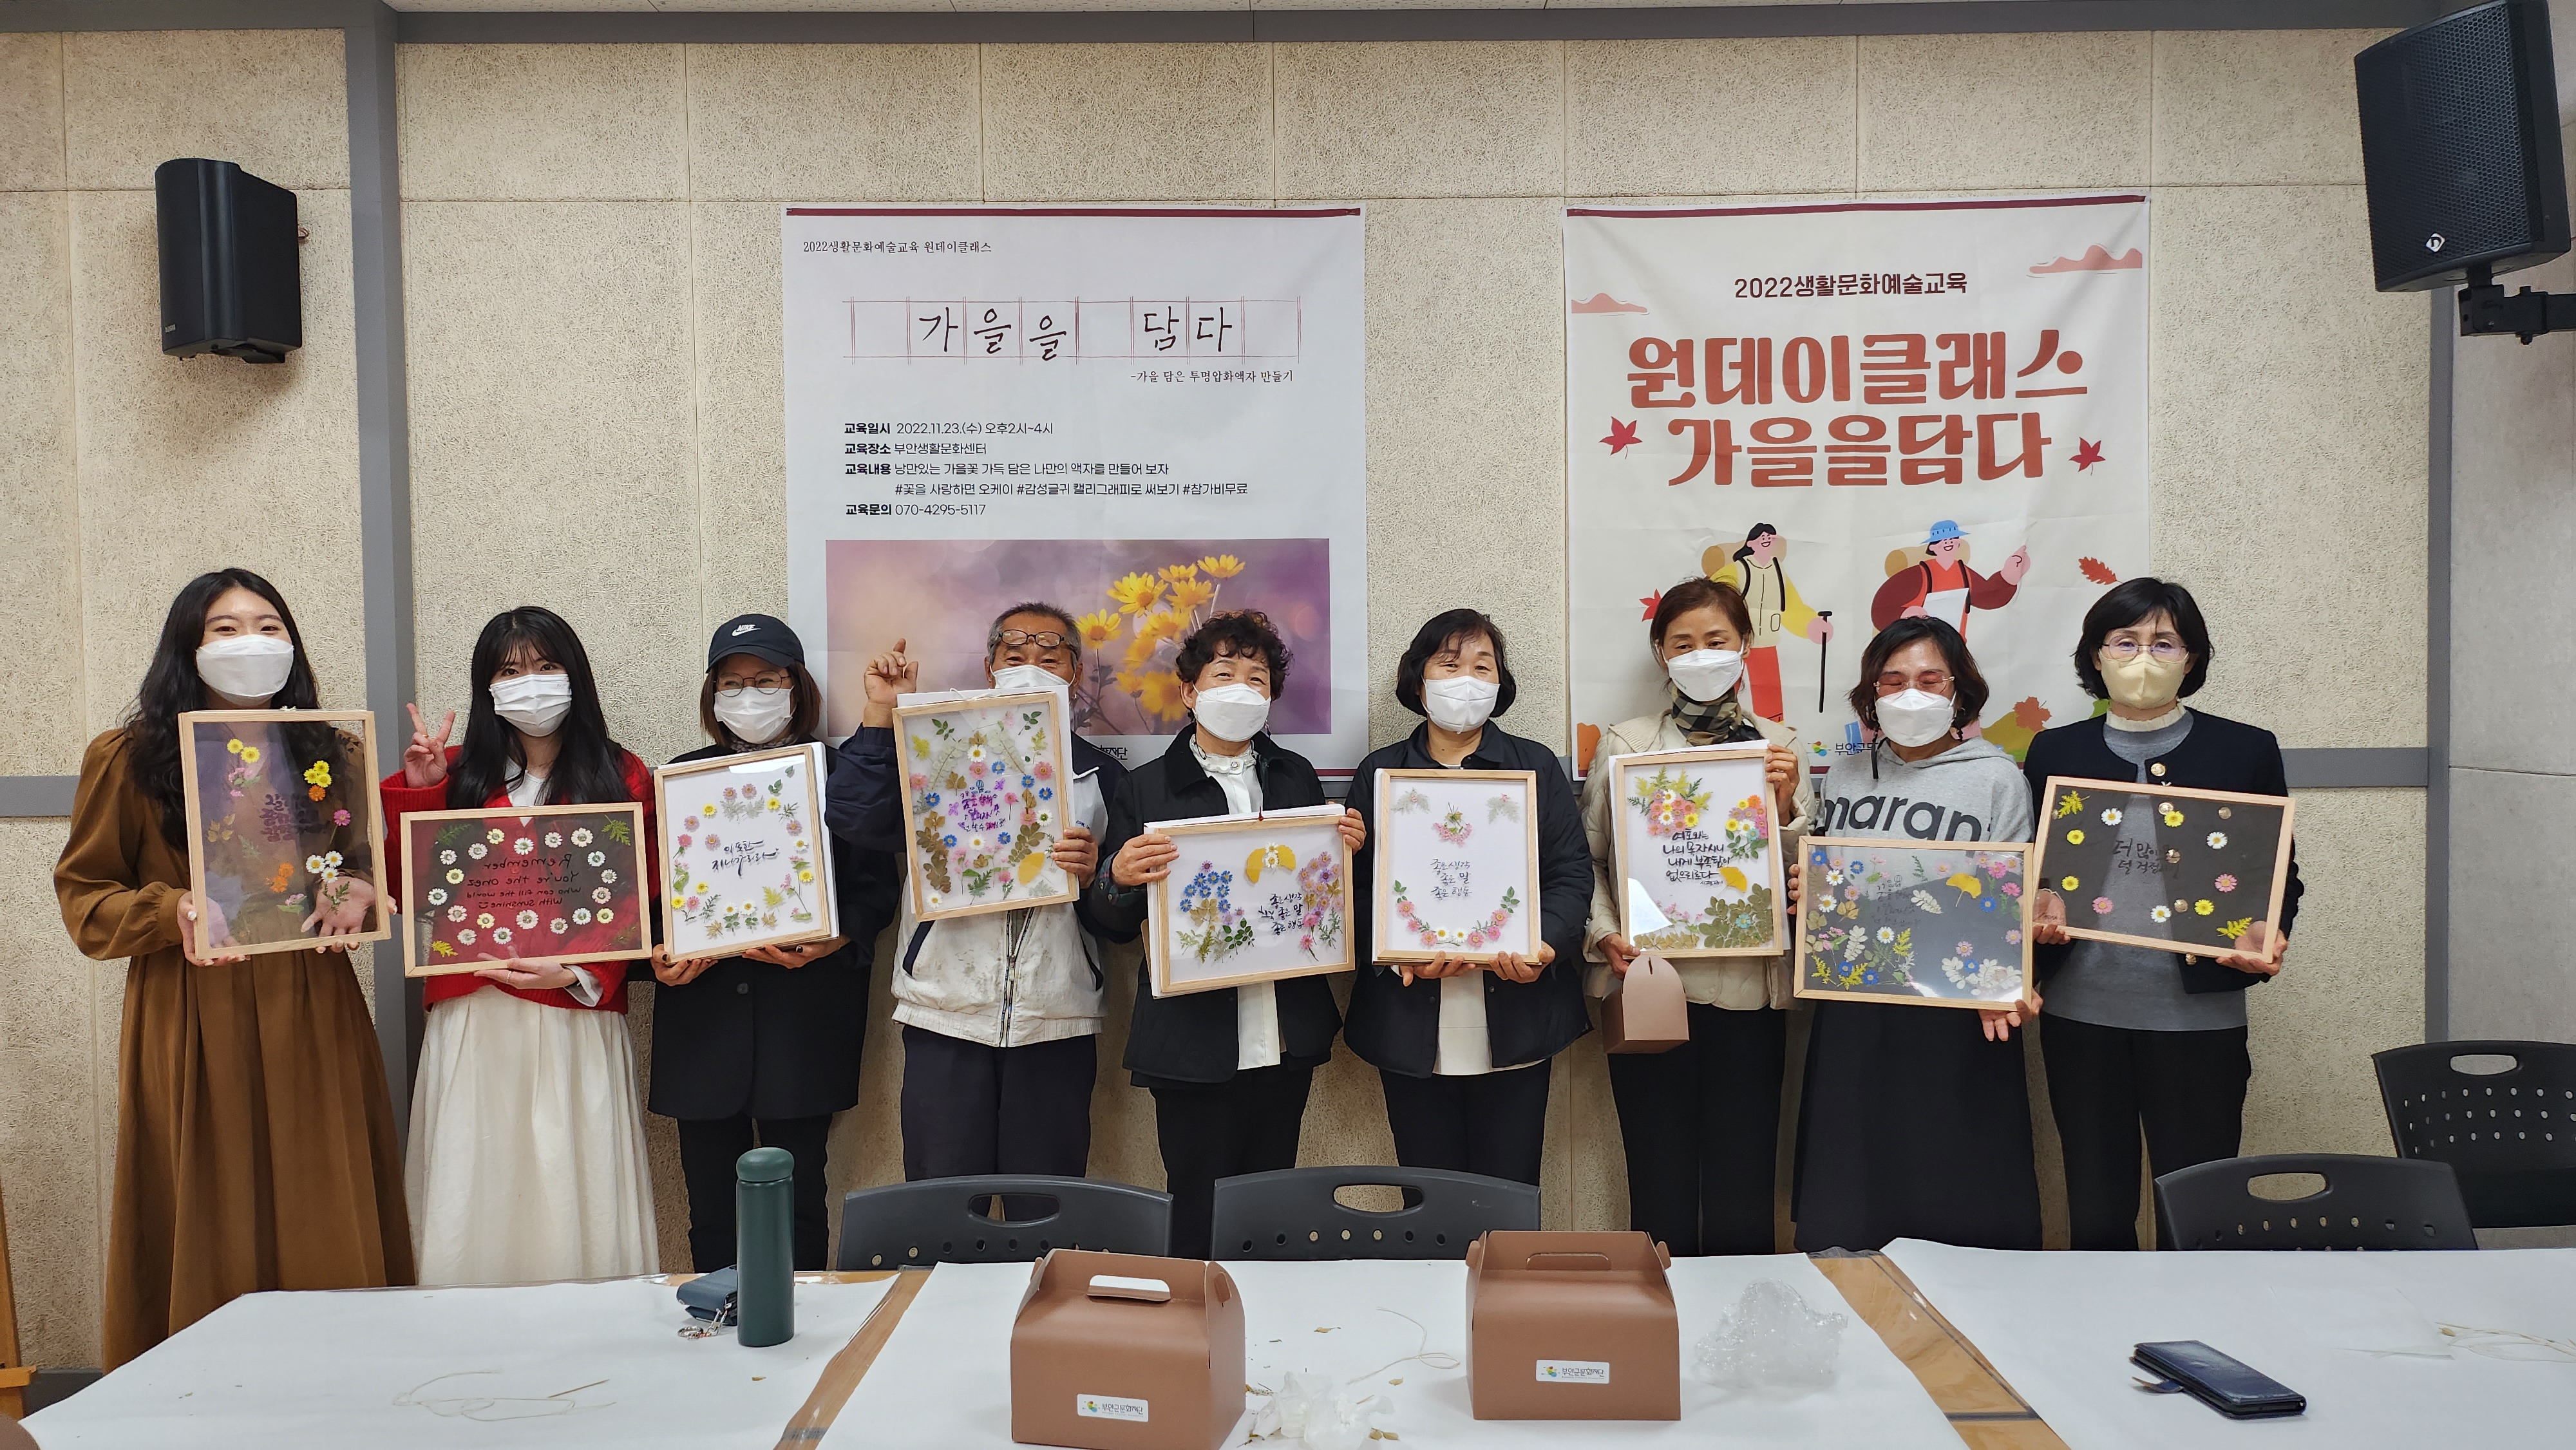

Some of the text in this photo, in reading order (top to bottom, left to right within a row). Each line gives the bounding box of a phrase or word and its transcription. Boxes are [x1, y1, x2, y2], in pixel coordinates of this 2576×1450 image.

[803, 240, 992, 253] 2022생활문화예술교육 원데이클래스
[1734, 272, 1968, 299] 2022생활문화예술교육
[918, 305, 1233, 361] 가을을 담다
[1627, 328, 2088, 410] 원데이클래스
[1130, 370, 1293, 383] -가을 담은 투명압화액자 만들기
[844, 422, 1054, 435] 교육일시 2022.11.23.(수) 오후2시~4시
[844, 443, 987, 455] 교육장소 부안생활문화센터
[1667, 411, 2052, 487] 가을을담다
[845, 463, 1169, 475] 교육내용 낭만있는 가을꽃 가득 담은 나만의 액자를 만들어 보자
[895, 483, 1248, 495] #꽃을 사랑하면 오케이 #감성글귀 캘리그래피로 써보기 #참가비무료
[846, 504, 986, 516] 교육문의 070-4295-5117
[1672, 828, 1709, 840] 여호와는
[1663, 844, 1684, 854] 나의
[2112, 838, 2133, 857] 더
[1430, 858, 1470, 875] 좋은 생각
[1668, 858, 1692, 867] 내게
[1440, 872, 1471, 886] 좋은 말
[1430, 886, 1472, 900] 좋은 행동
[1270, 892, 1302, 909] 좋은 생각
[1278, 907, 1291, 921] 좋은
[1293, 903, 1303, 916] 말
[1271, 918, 1304, 936] 좋은 행동
[1562, 1368, 1604, 1377] 부안군문화재단
[1102, 1403, 1143, 1415] 부안군문화재단
